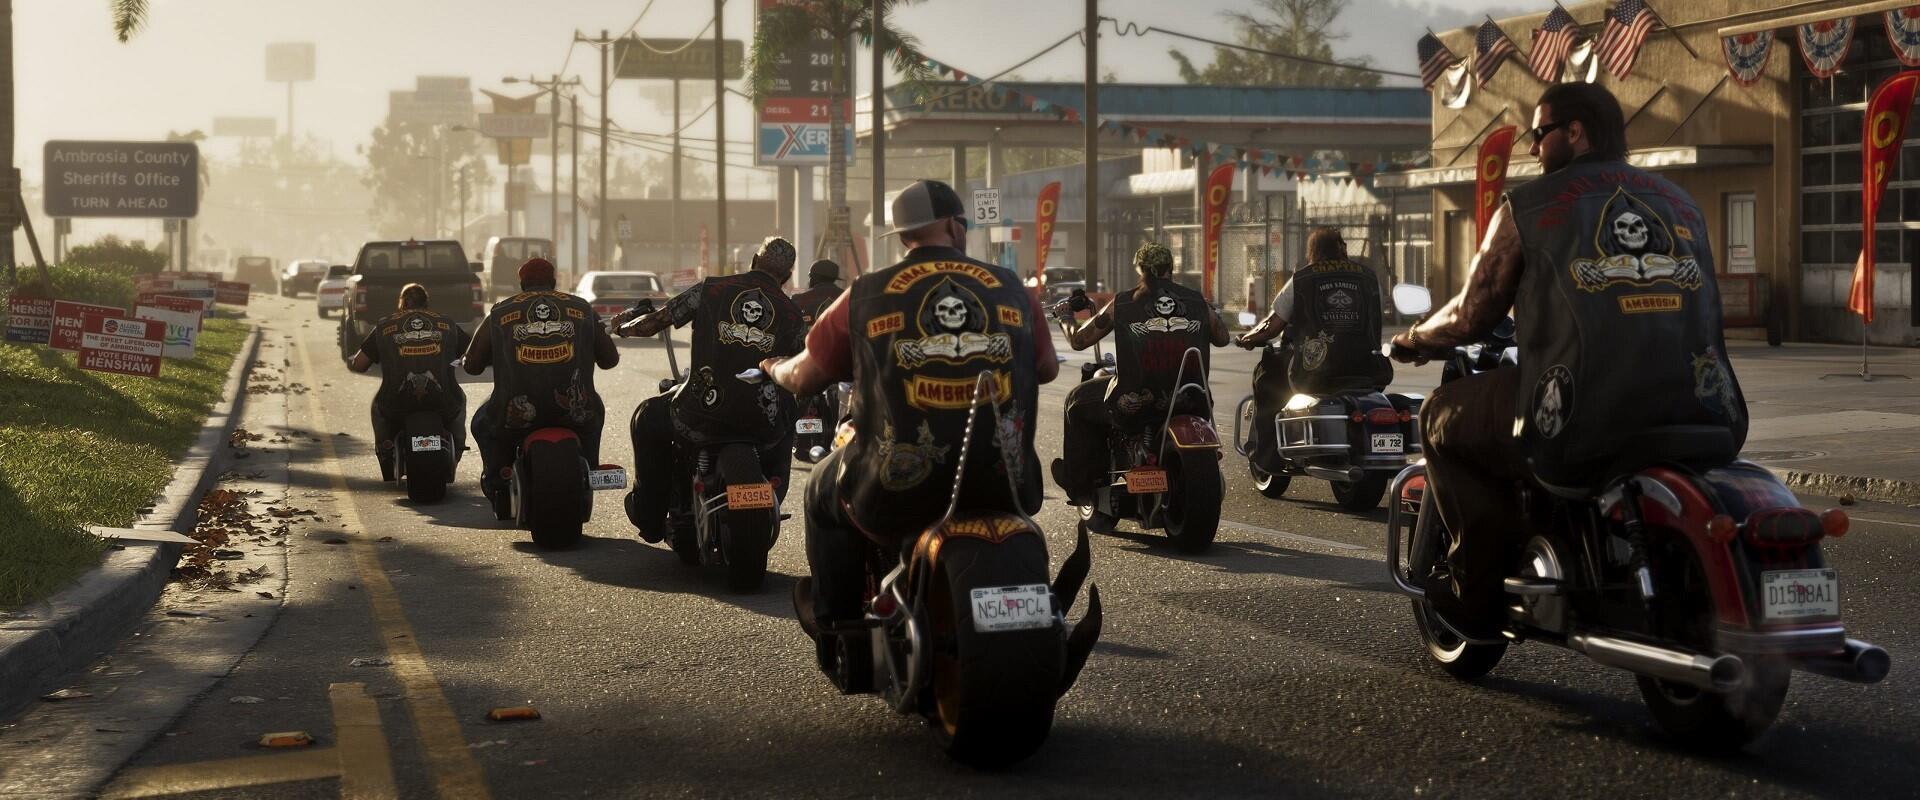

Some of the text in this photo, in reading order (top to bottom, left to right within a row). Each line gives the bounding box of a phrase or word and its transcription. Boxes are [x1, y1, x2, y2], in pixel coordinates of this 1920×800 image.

[775, 124, 830, 159] XER
[52, 149, 190, 166] Ambrosia County
[63, 171, 181, 186] Sheriffs Office
[72, 197, 168, 209] TURN AHEAD
[977, 206, 998, 220] 35
[890, 261, 998, 290] FINAL CHAPTER
[1625, 295, 1677, 310] AMBROSIA
[12, 304, 53, 316] HENSH
[1001, 310, 1020, 323] MC
[59, 328, 79, 338] FOR
[100, 336, 123, 344] SWEET
[124, 339, 160, 348] LIFEBLOOD
[110, 343, 145, 352] AMBROSIA
[98, 350, 142, 362] VOTE ERIN
[522, 345, 569, 361] AMBROSIA
[86, 357, 153, 374] HENSHAW
[1389, 439, 1402, 448] 732
